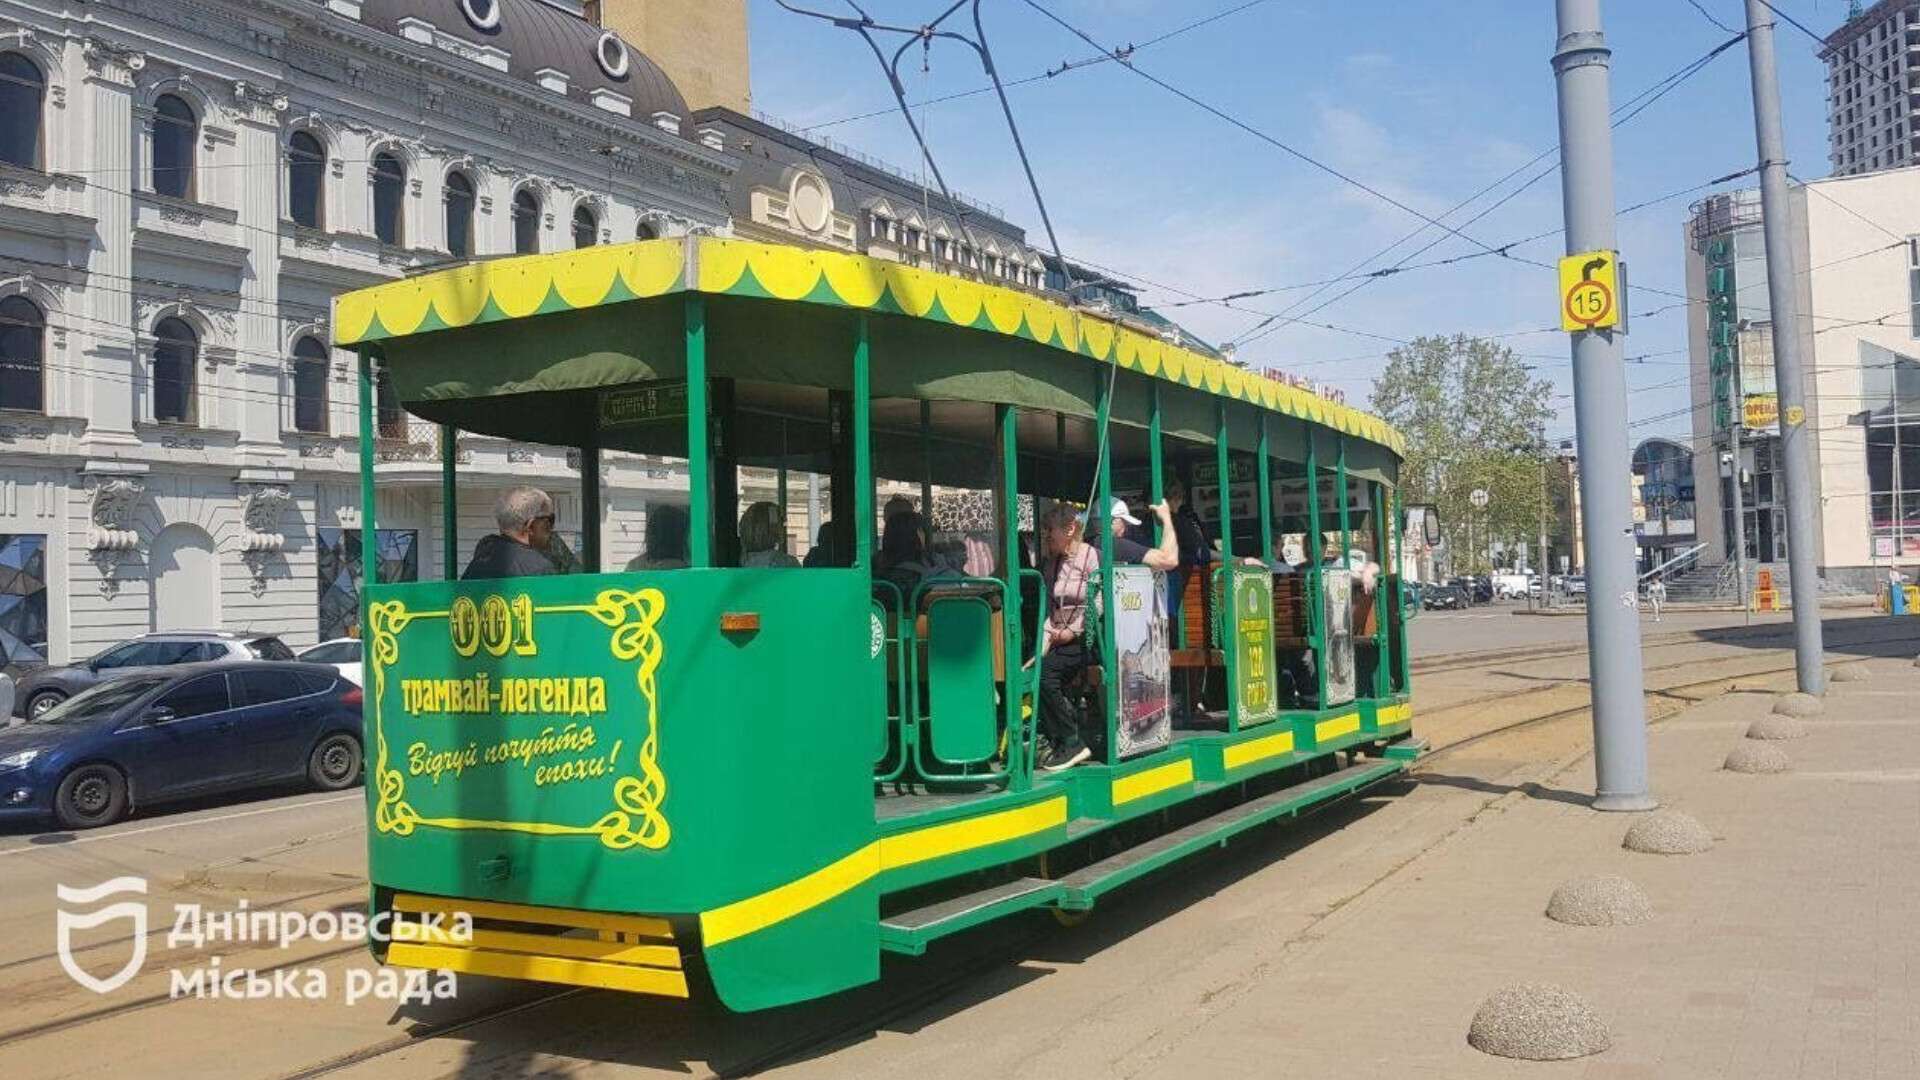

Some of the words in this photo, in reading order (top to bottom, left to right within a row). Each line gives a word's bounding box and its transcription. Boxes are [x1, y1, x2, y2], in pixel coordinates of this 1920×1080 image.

[1575, 291, 1602, 314] 15
[450, 593, 538, 657] 001
[401, 672, 607, 717] трамвай-легенда
[408, 741, 477, 785] Відчуй
[484, 723, 598, 767] почуття
[535, 740, 622, 786] епохи!
